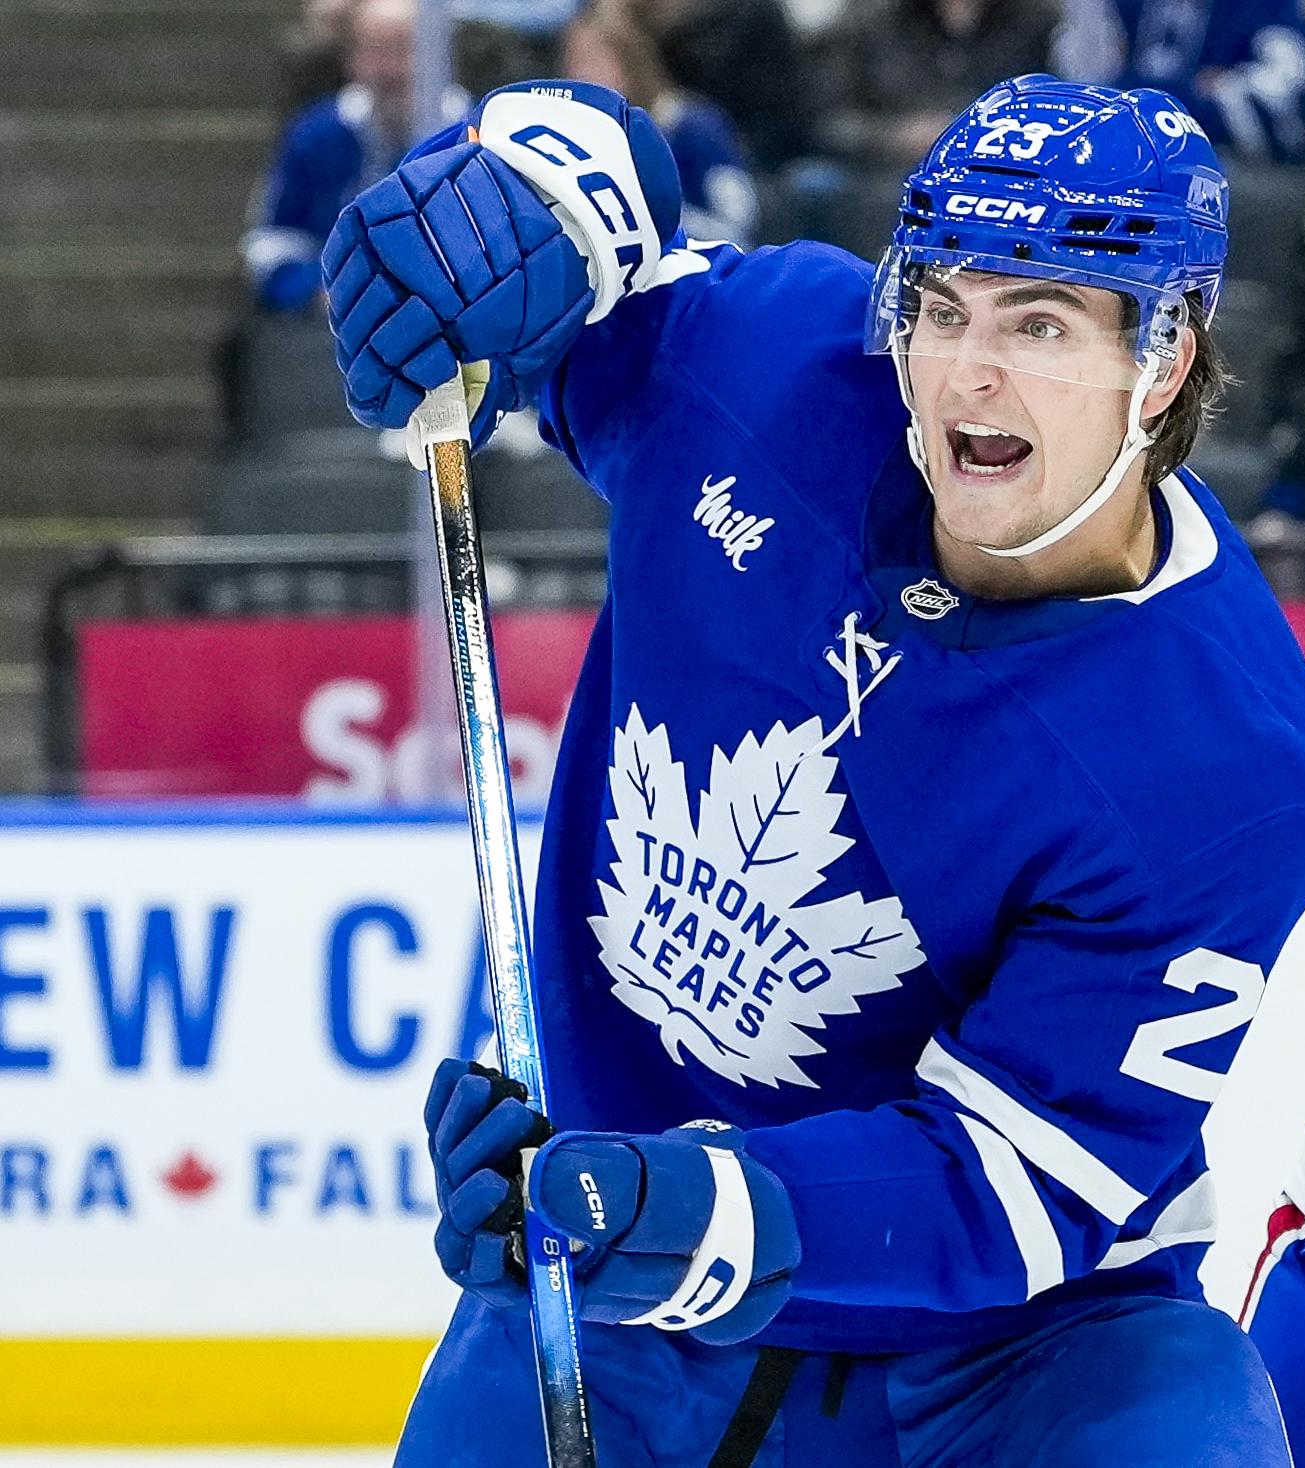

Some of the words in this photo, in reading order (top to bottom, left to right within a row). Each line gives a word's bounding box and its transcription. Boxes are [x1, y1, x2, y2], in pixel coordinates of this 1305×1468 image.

[531, 87, 573, 101] KNIES
[973, 118, 1053, 159] 23
[945, 194, 1047, 225] CCM
[694, 474, 776, 571] Milk
[636, 830, 831, 994] TORONTO
[644, 883, 784, 1007] MAPLE
[0, 905, 236, 1072] EW
[629, 920, 766, 1039] LEAFS
[0, 1144, 132, 1215] RA
[579, 1172, 606, 1230] CCM
